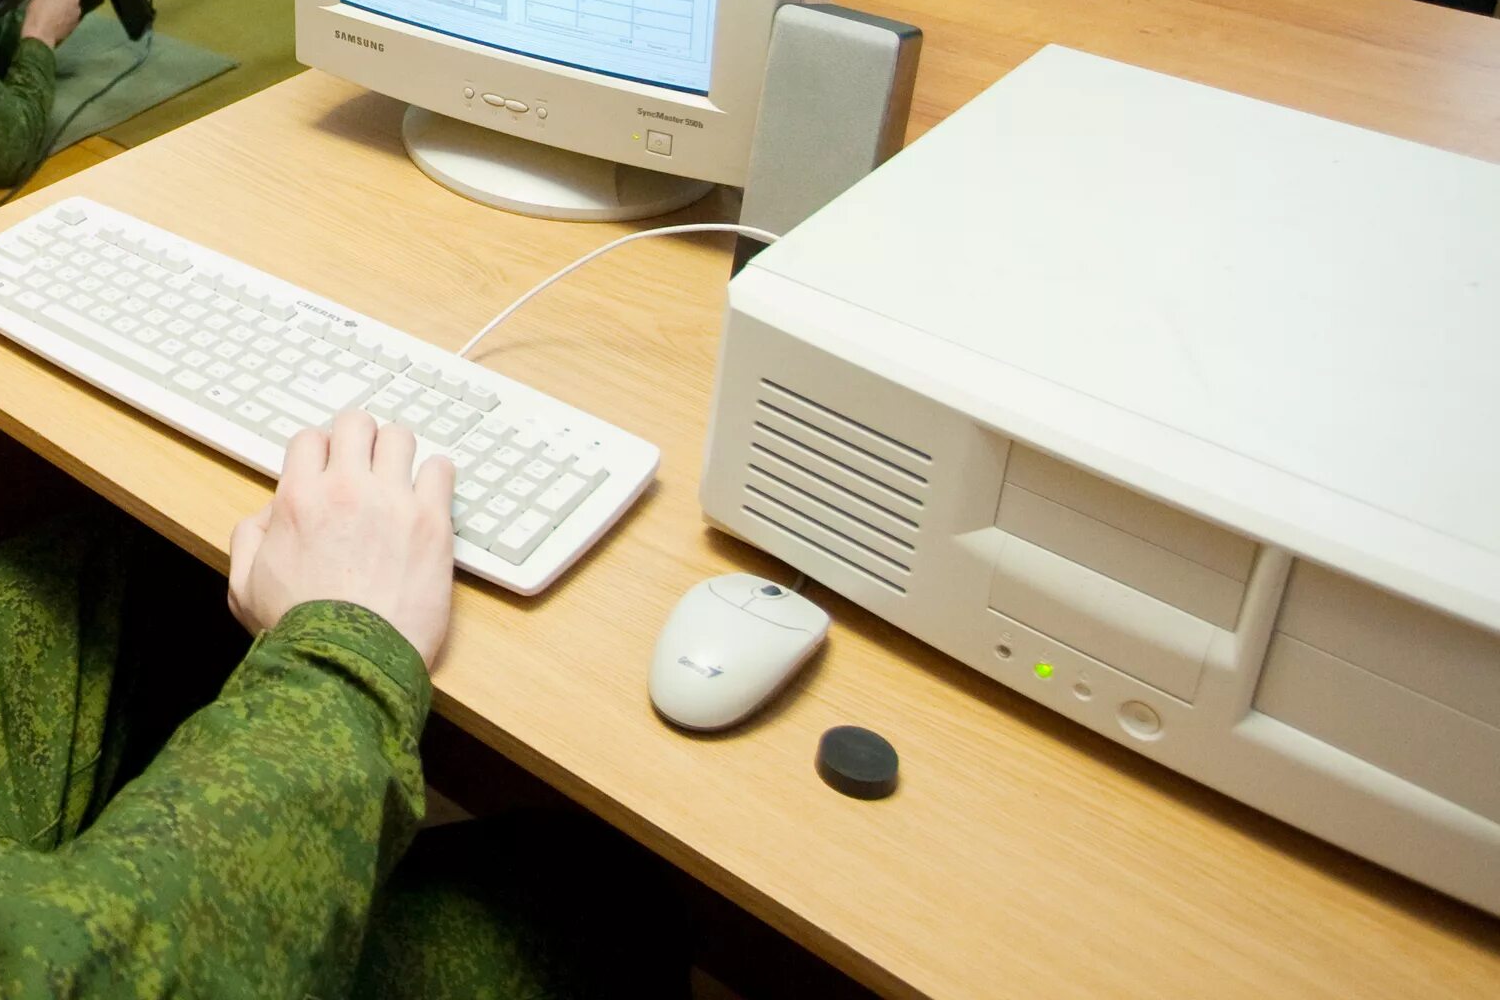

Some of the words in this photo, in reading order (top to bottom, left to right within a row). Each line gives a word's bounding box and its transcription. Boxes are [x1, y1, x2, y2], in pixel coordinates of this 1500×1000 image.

[334, 30, 385, 52] SAMSUNG
[637, 107, 684, 125] SyncMaster
[296, 300, 342, 322] CHERRY
